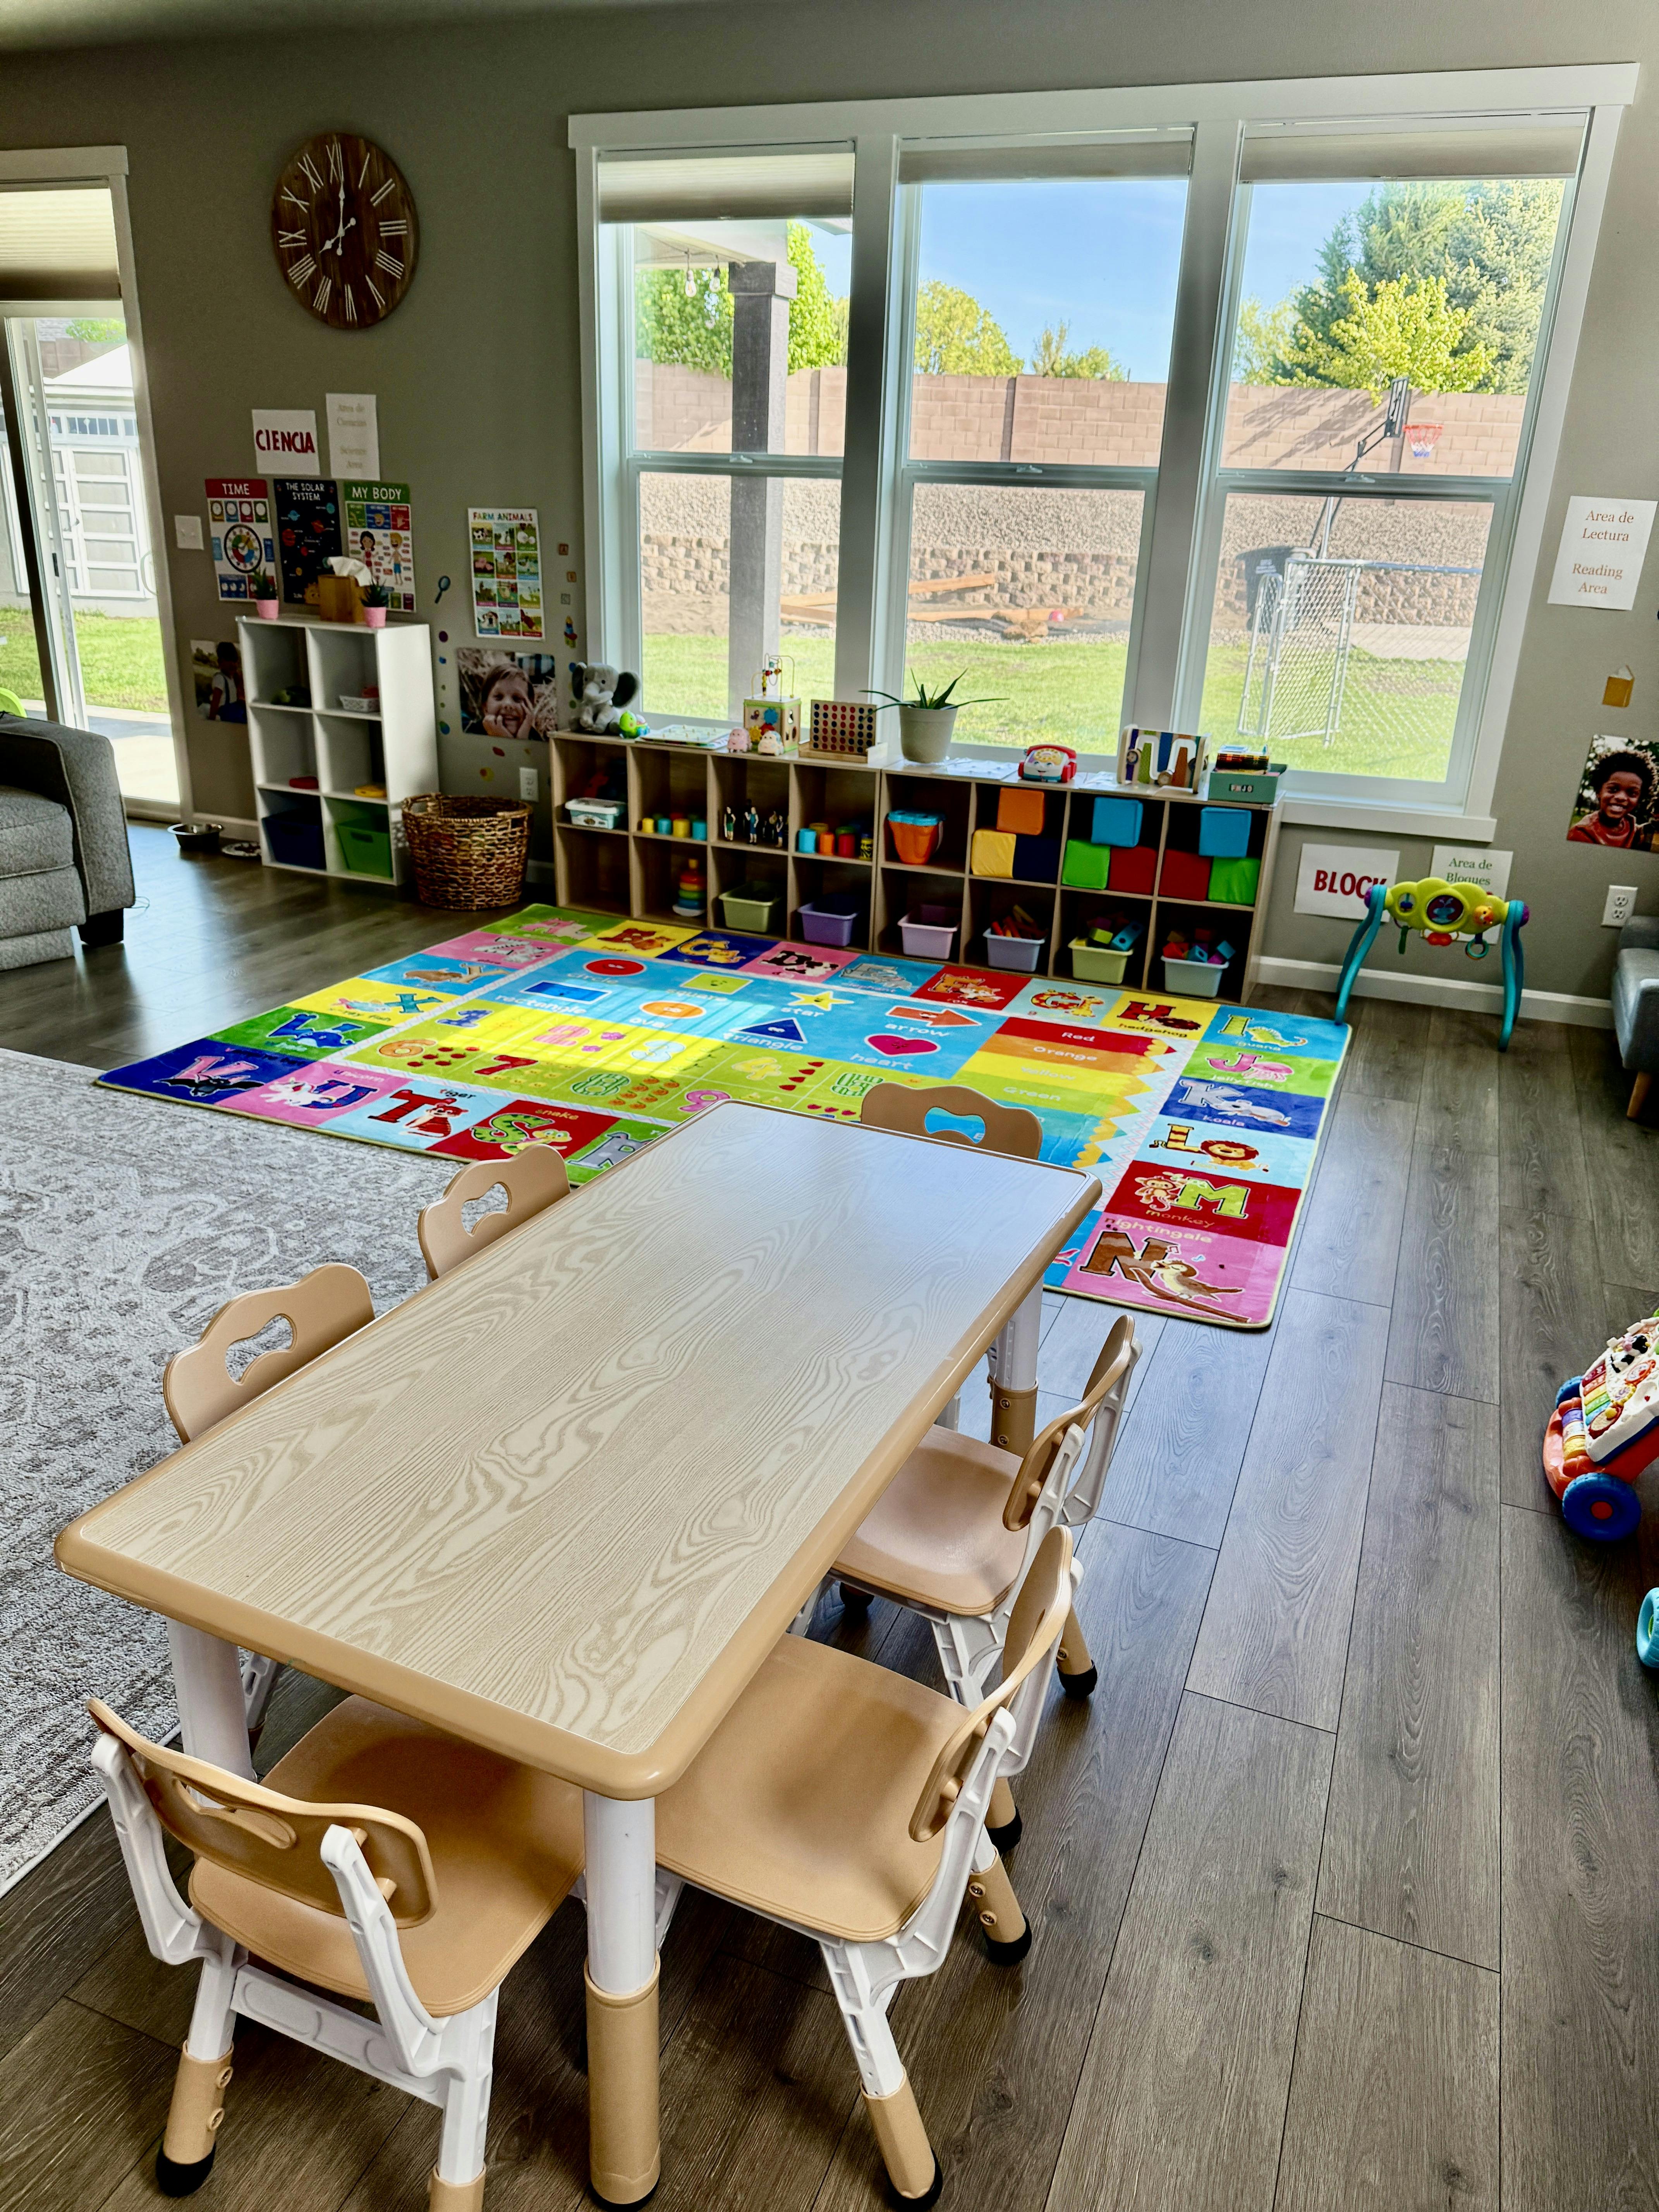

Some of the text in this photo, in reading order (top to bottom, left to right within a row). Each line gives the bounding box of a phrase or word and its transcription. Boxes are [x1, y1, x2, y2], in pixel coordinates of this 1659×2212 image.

[365, 275, 386, 309] V
[256, 429, 315, 453] CIENCIA
[222, 483, 250, 495] TIME
[285, 482, 325, 492] THE SOLAR
[292, 492, 320, 501] SYSTEM
[352, 487, 402, 500] MY BODY
[473, 512, 533, 521] FARM ANIMALS
[1585, 510, 1634, 523] Area de
[1582, 528, 1629, 541] Lectura
[1571, 563, 1623, 580] Reading
[1578, 582, 1607, 594] Area
[1448, 858, 1492, 870] Area de
[567, 973, 619, 984] circle
[495, 994, 587, 1014] rectangle
[666, 989, 728, 1002] square
[1030, 990, 1082, 1010] G
[436, 1010, 494, 1029] 1
[780, 1007, 825, 1017] star
[1116, 1001, 1176, 1020] H
[629, 1018, 675, 1029] oval
[884, 1023, 951, 1037] arrow
[1119, 1023, 1188, 1037] hedgehog
[1218, 1013, 1254, 1037] I
[532, 1025, 591, 1046] 2
[722, 1032, 804, 1051] triangle
[1061, 1032, 1096, 1042] Red
[377, 1038, 438, 1058] 6
[630, 1040, 686, 1063] 3
[1033, 1046, 1097, 1061] Orange
[473, 1054, 539, 1075] 7
[732, 1057, 782, 1081] 4
[850, 1053, 914, 1070] heart
[1206, 1052, 1262, 1073] J
[440, 1089, 477, 1099] tiger
[571, 1073, 630, 1097] 8
[830, 1072, 885, 1097] 5
[1003, 1086, 1061, 1101] Green
[1178, 1079, 1245, 1108] K
[299, 1079, 380, 1110] U
[679, 1089, 731, 1113] 9
[368, 1089, 457, 1124] T
[534, 1108, 580, 1120] snake
[470, 1112, 555, 1144] S
[1165, 1123, 1208, 1155] L
[1171, 1176, 1250, 1219] M
[1145, 1208, 1216, 1228] monkey
[1104, 1217, 1213, 1243] nightingale
[1079, 1230, 1180, 1283] N
